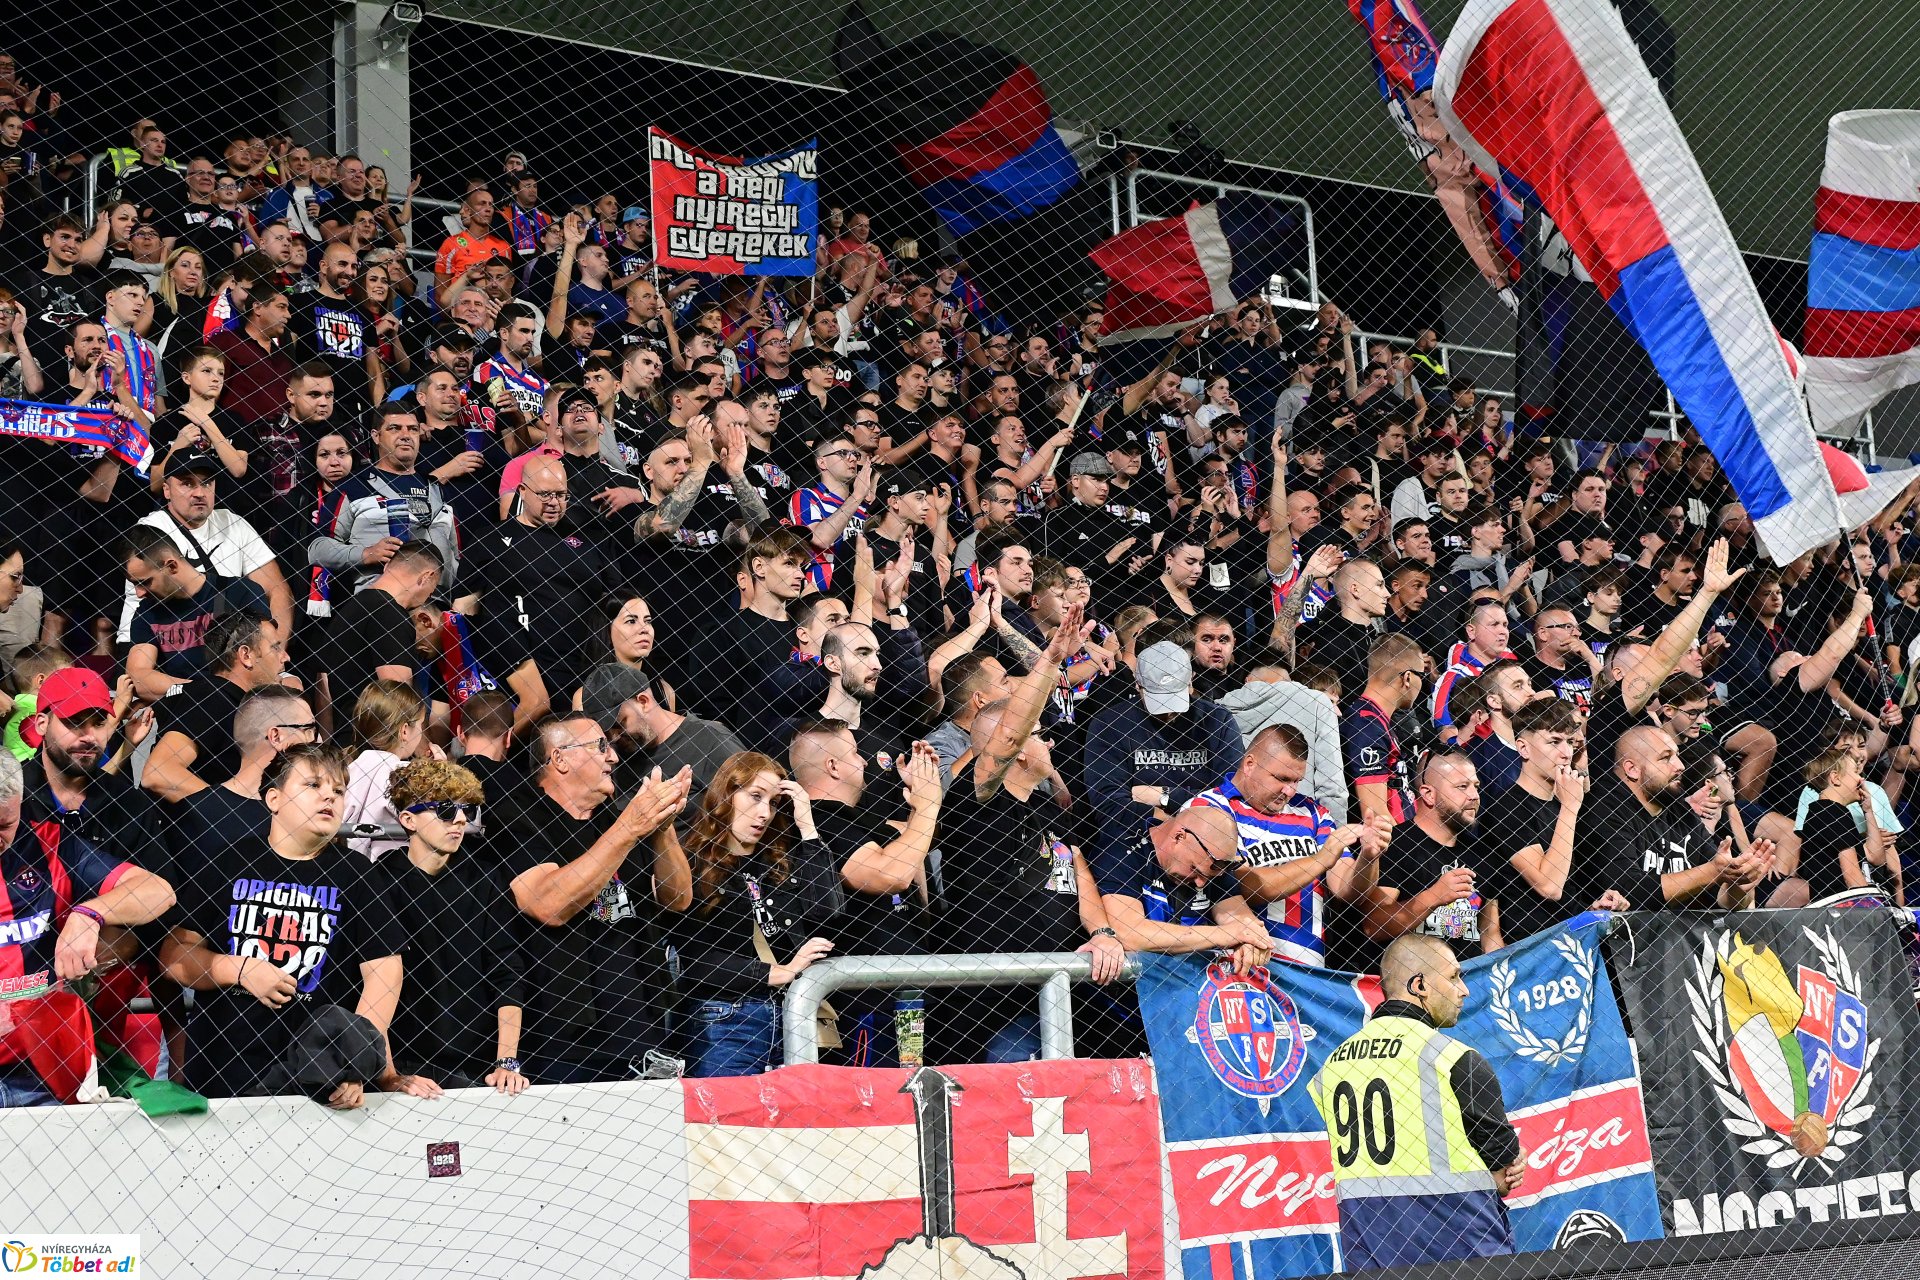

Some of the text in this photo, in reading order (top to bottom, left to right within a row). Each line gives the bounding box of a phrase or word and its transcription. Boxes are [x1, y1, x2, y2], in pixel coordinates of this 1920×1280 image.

[316, 316, 362, 338] ULTRAS
[316, 329, 362, 358] 1928
[231, 877, 342, 912] ORIGINAL
[228, 903, 338, 950] ULTRAS
[1517, 975, 1581, 1013] 1928
[1329, 1034, 1405, 1064] RENDEZŐ
[1332, 1077, 1396, 1168] 90
[432, 1153, 456, 1166] 1928
